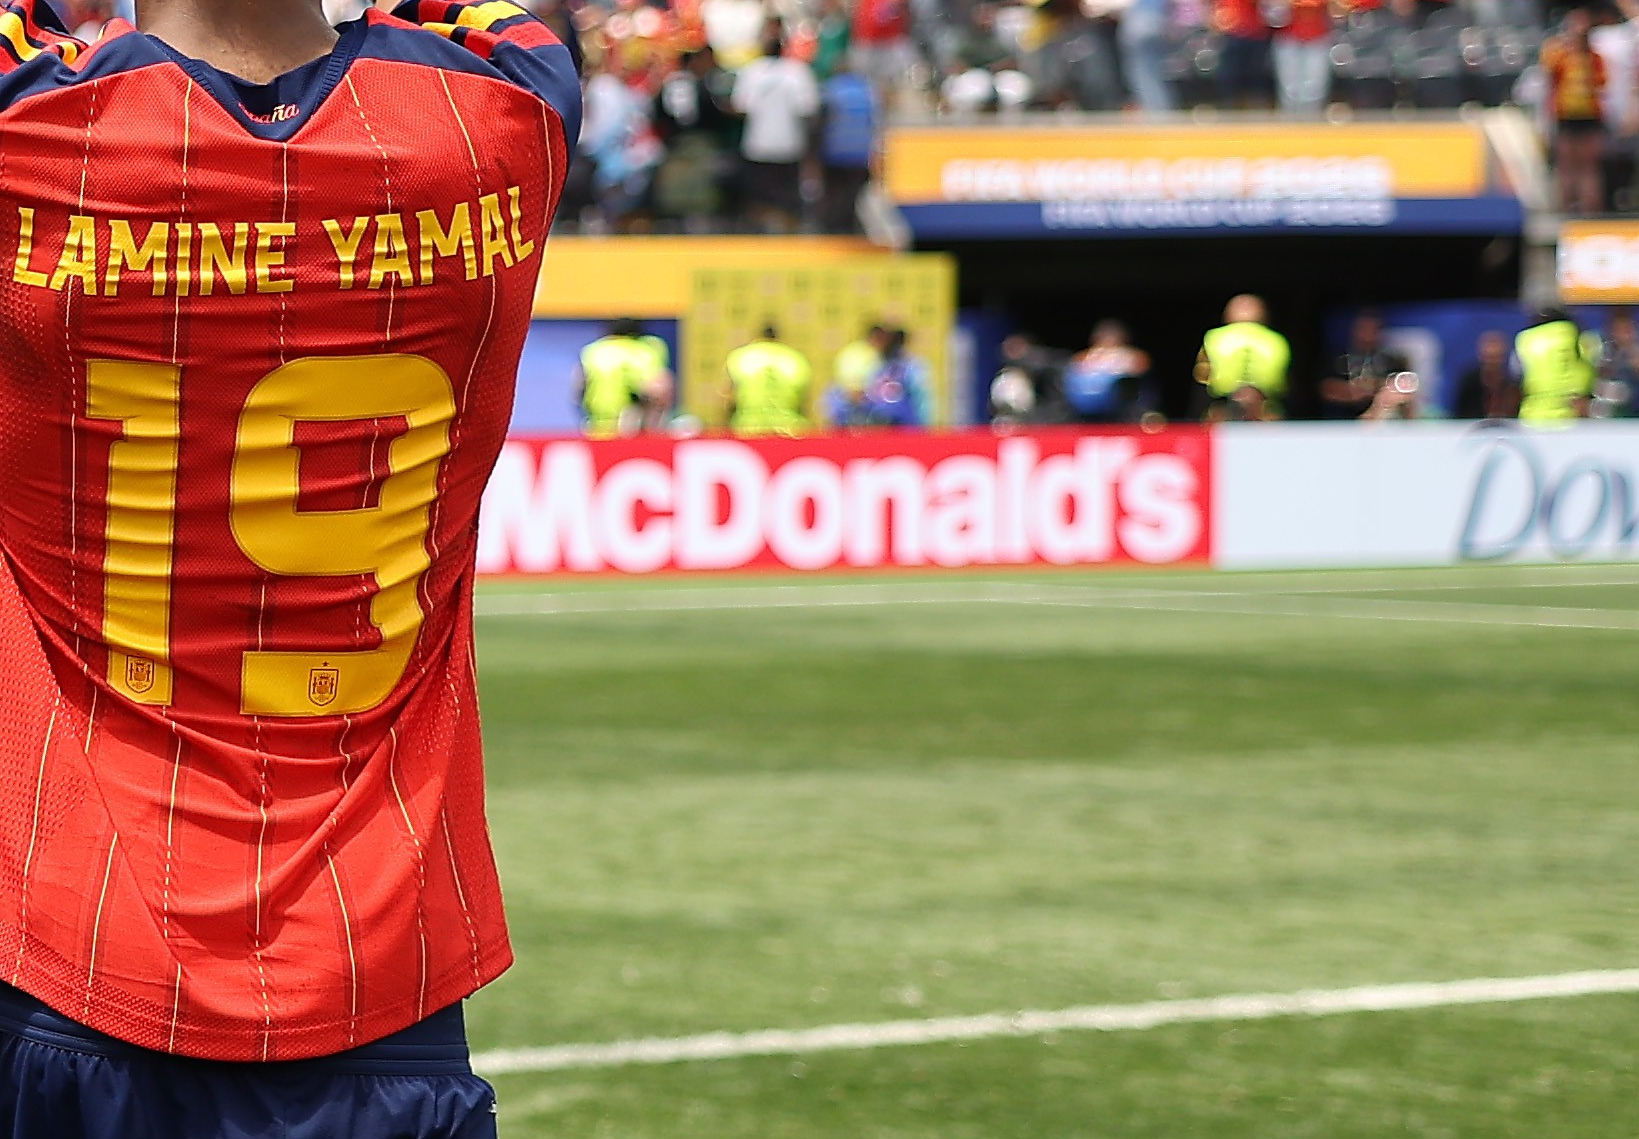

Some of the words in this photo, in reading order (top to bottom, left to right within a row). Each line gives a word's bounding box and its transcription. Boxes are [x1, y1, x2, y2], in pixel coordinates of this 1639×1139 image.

[12, 206, 296, 297] LAMINE
[321, 185, 535, 290] YAMAL
[84, 352, 457, 718] 19
[474, 437, 1203, 573] McDonald's
